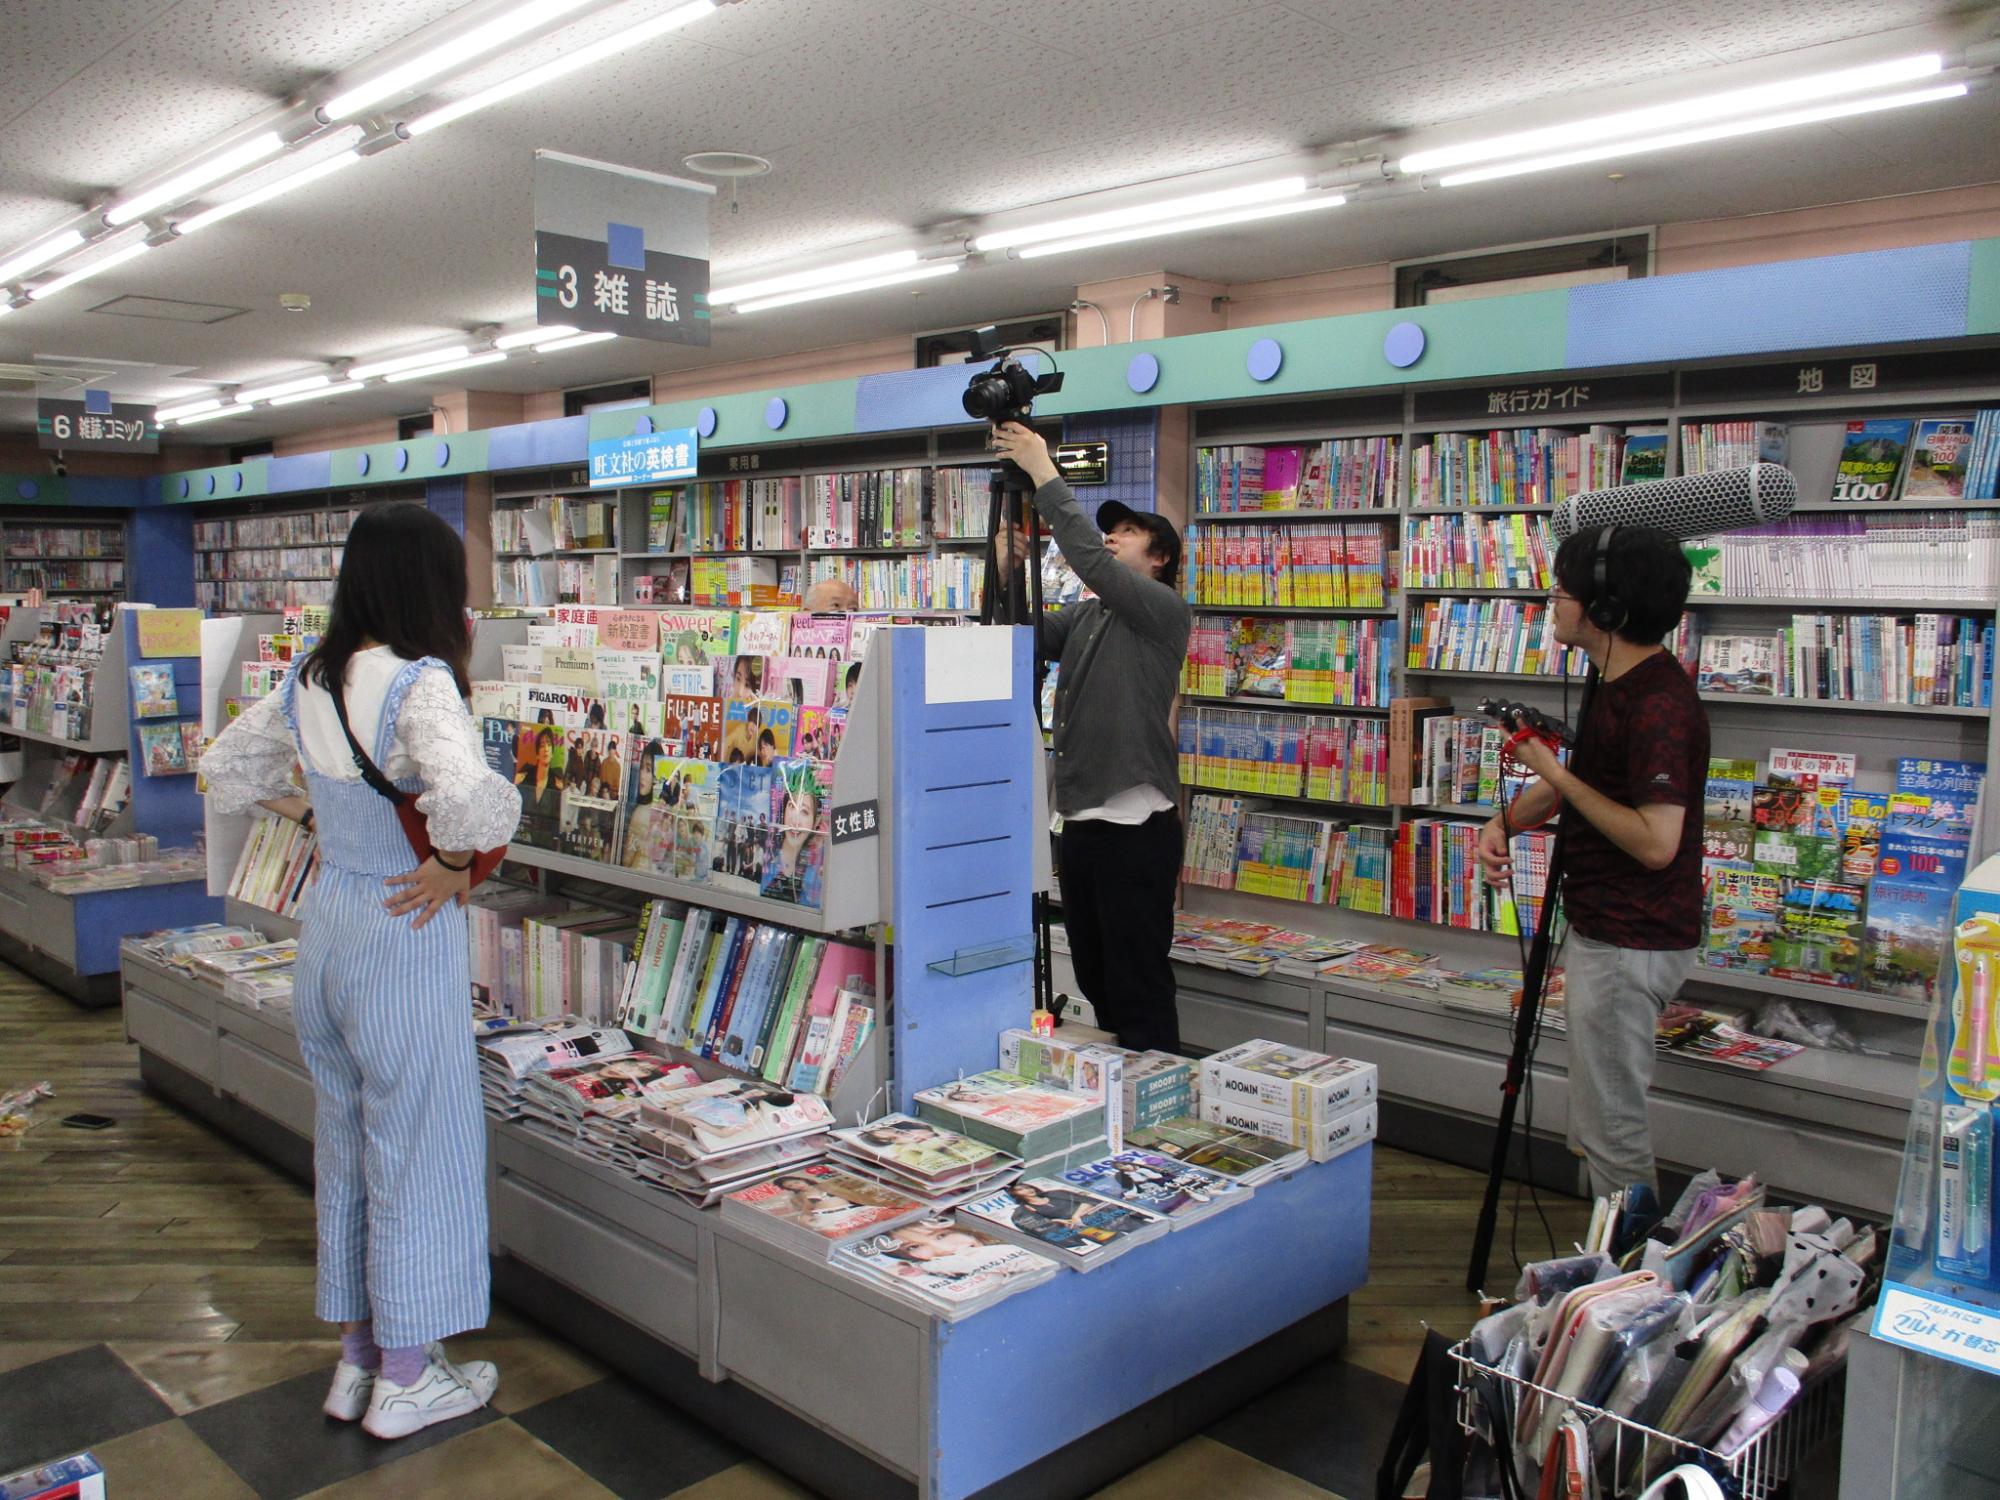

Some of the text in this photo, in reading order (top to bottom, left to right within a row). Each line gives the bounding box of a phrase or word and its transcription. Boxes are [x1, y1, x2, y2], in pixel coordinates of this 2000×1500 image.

[559, 265, 679, 322] 3 雑誌
[1797, 363, 1876, 393] 地図
[1487, 386, 1590, 413] 旅行ガイド
[54, 415, 144, 441] 6 雑誌・コミック
[594, 443, 689, 476] 旺文社の英検書
[1933, 451, 1956, 462] 100
[1833, 483, 1889, 500] 100
[528, 690, 568, 705] FIGARO
[667, 698, 720, 724] FUDGE
[1773, 756, 1850, 777] 関東の神社
[835, 808, 876, 837] 女性誌
[1225, 1080, 1259, 1096] MOOMIN
[1328, 1086, 1350, 1105] MOOMIN
[1225, 1115, 1259, 1132] MOOMIN
[1328, 1124, 1350, 1143] MOOMIN
